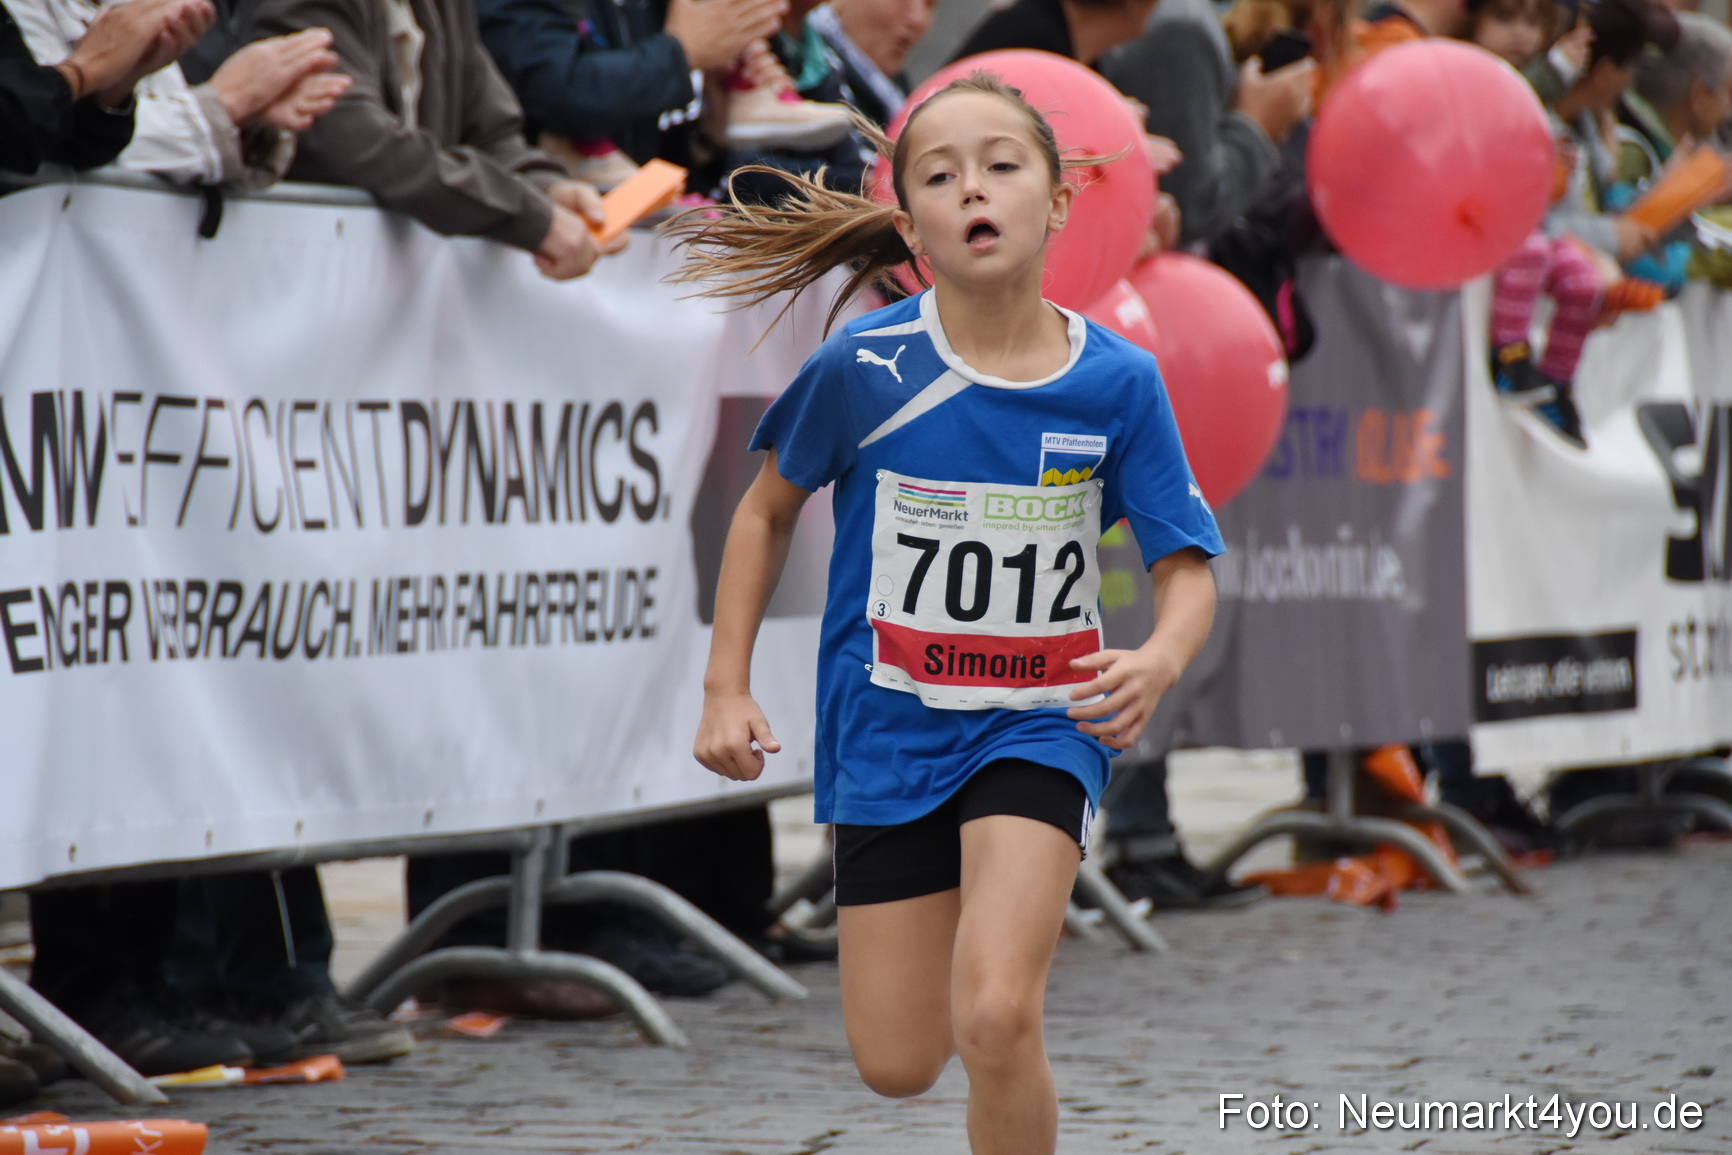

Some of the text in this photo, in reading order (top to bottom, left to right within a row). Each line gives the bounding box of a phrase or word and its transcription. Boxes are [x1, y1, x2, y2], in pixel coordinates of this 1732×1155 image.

[1044, 436, 1104, 449] MTV Pfaffenhofen
[893, 500, 969, 522] NeuerMarkt
[984, 490, 1088, 521] BOCK
[920, 520, 936, 528] leben
[982, 521, 1020, 532] inspired
[1021, 521, 1033, 533] by
[1035, 522, 1061, 532] smart
[896, 533, 1085, 624] 7012
[367, 575, 447, 656] MEHR
[877, 602, 887, 617] 3
[1084, 610, 1093, 626] K
[924, 643, 1047, 679] Simone
